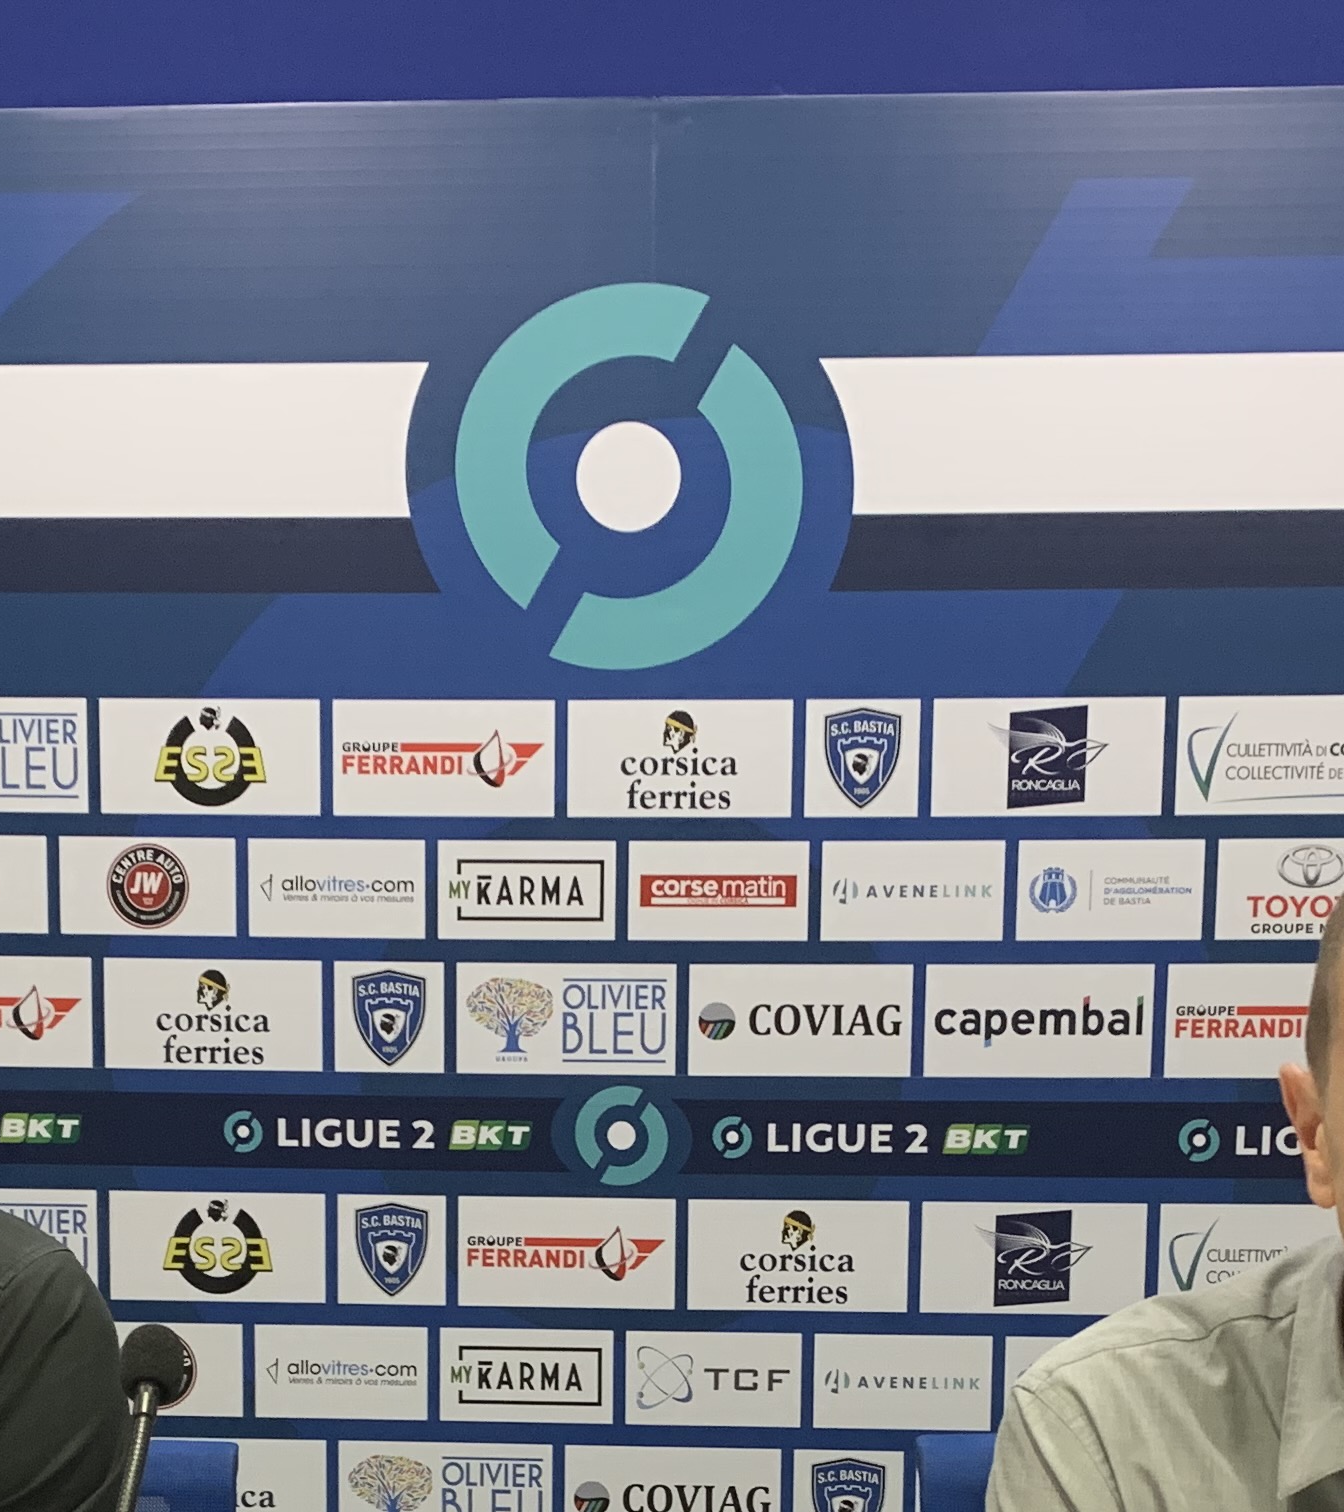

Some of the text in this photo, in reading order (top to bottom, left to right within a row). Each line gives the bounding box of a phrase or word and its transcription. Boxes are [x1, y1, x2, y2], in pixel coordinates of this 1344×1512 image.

[831, 720, 894, 737] S.C. BASTIA
[342, 741, 399, 753] GROUPE
[1226, 739, 1312, 757] CULLETTIVITÀ
[1315, 745, 1327, 756] DI
[342, 754, 463, 775] FERRANDI
[620, 747, 738, 776] corsica
[1225, 762, 1324, 780] COLLECTIVITÉ
[1328, 768, 1344, 780] DE
[627, 779, 731, 809] ferries
[1011, 780, 1081, 792] RONCAGLIA
[112, 849, 184, 884] CENTRE AUTO
[129, 871, 164, 895] JW
[449, 875, 585, 906] MY KARMA
[866, 884, 993, 898] AVENELINK
[1118, 897, 1151, 905] BASTIA
[1247, 895, 1340, 918] TOYO
[358, 982, 420, 998] S.C. BASTIA
[563, 984, 665, 1010] OLIVIER
[156, 1005, 270, 1033] corsica
[749, 1004, 902, 1036] COVIAG
[934, 996, 1144, 1048] capembal
[1176, 1005, 1235, 1016] GROUPE
[563, 1012, 666, 1055] BLEU
[1174, 1018, 1302, 1039] FERRANDI
[163, 1037, 264, 1066] ferries
[0, 1119, 80, 1139] BKT
[277, 1118, 530, 1149] LIGUE 2 BKT
[767, 1123, 1027, 1154] LIGUE 2 BKT
[468, 1236, 523, 1248] GROUPE
[467, 1249, 585, 1269] FERRANDI
[740, 1246, 855, 1273] corsica
[746, 1276, 848, 1305] ferries
[999, 1280, 1065, 1291] RONCAGLIA
[450, 1360, 583, 1391] MY KARMA
[704, 1369, 790, 1392] TCF
[858, 1376, 980, 1390] AVENELINK
[442, 1462, 543, 1488] OLIVIER
[818, 1470, 880, 1485] S.C. BASTIA
